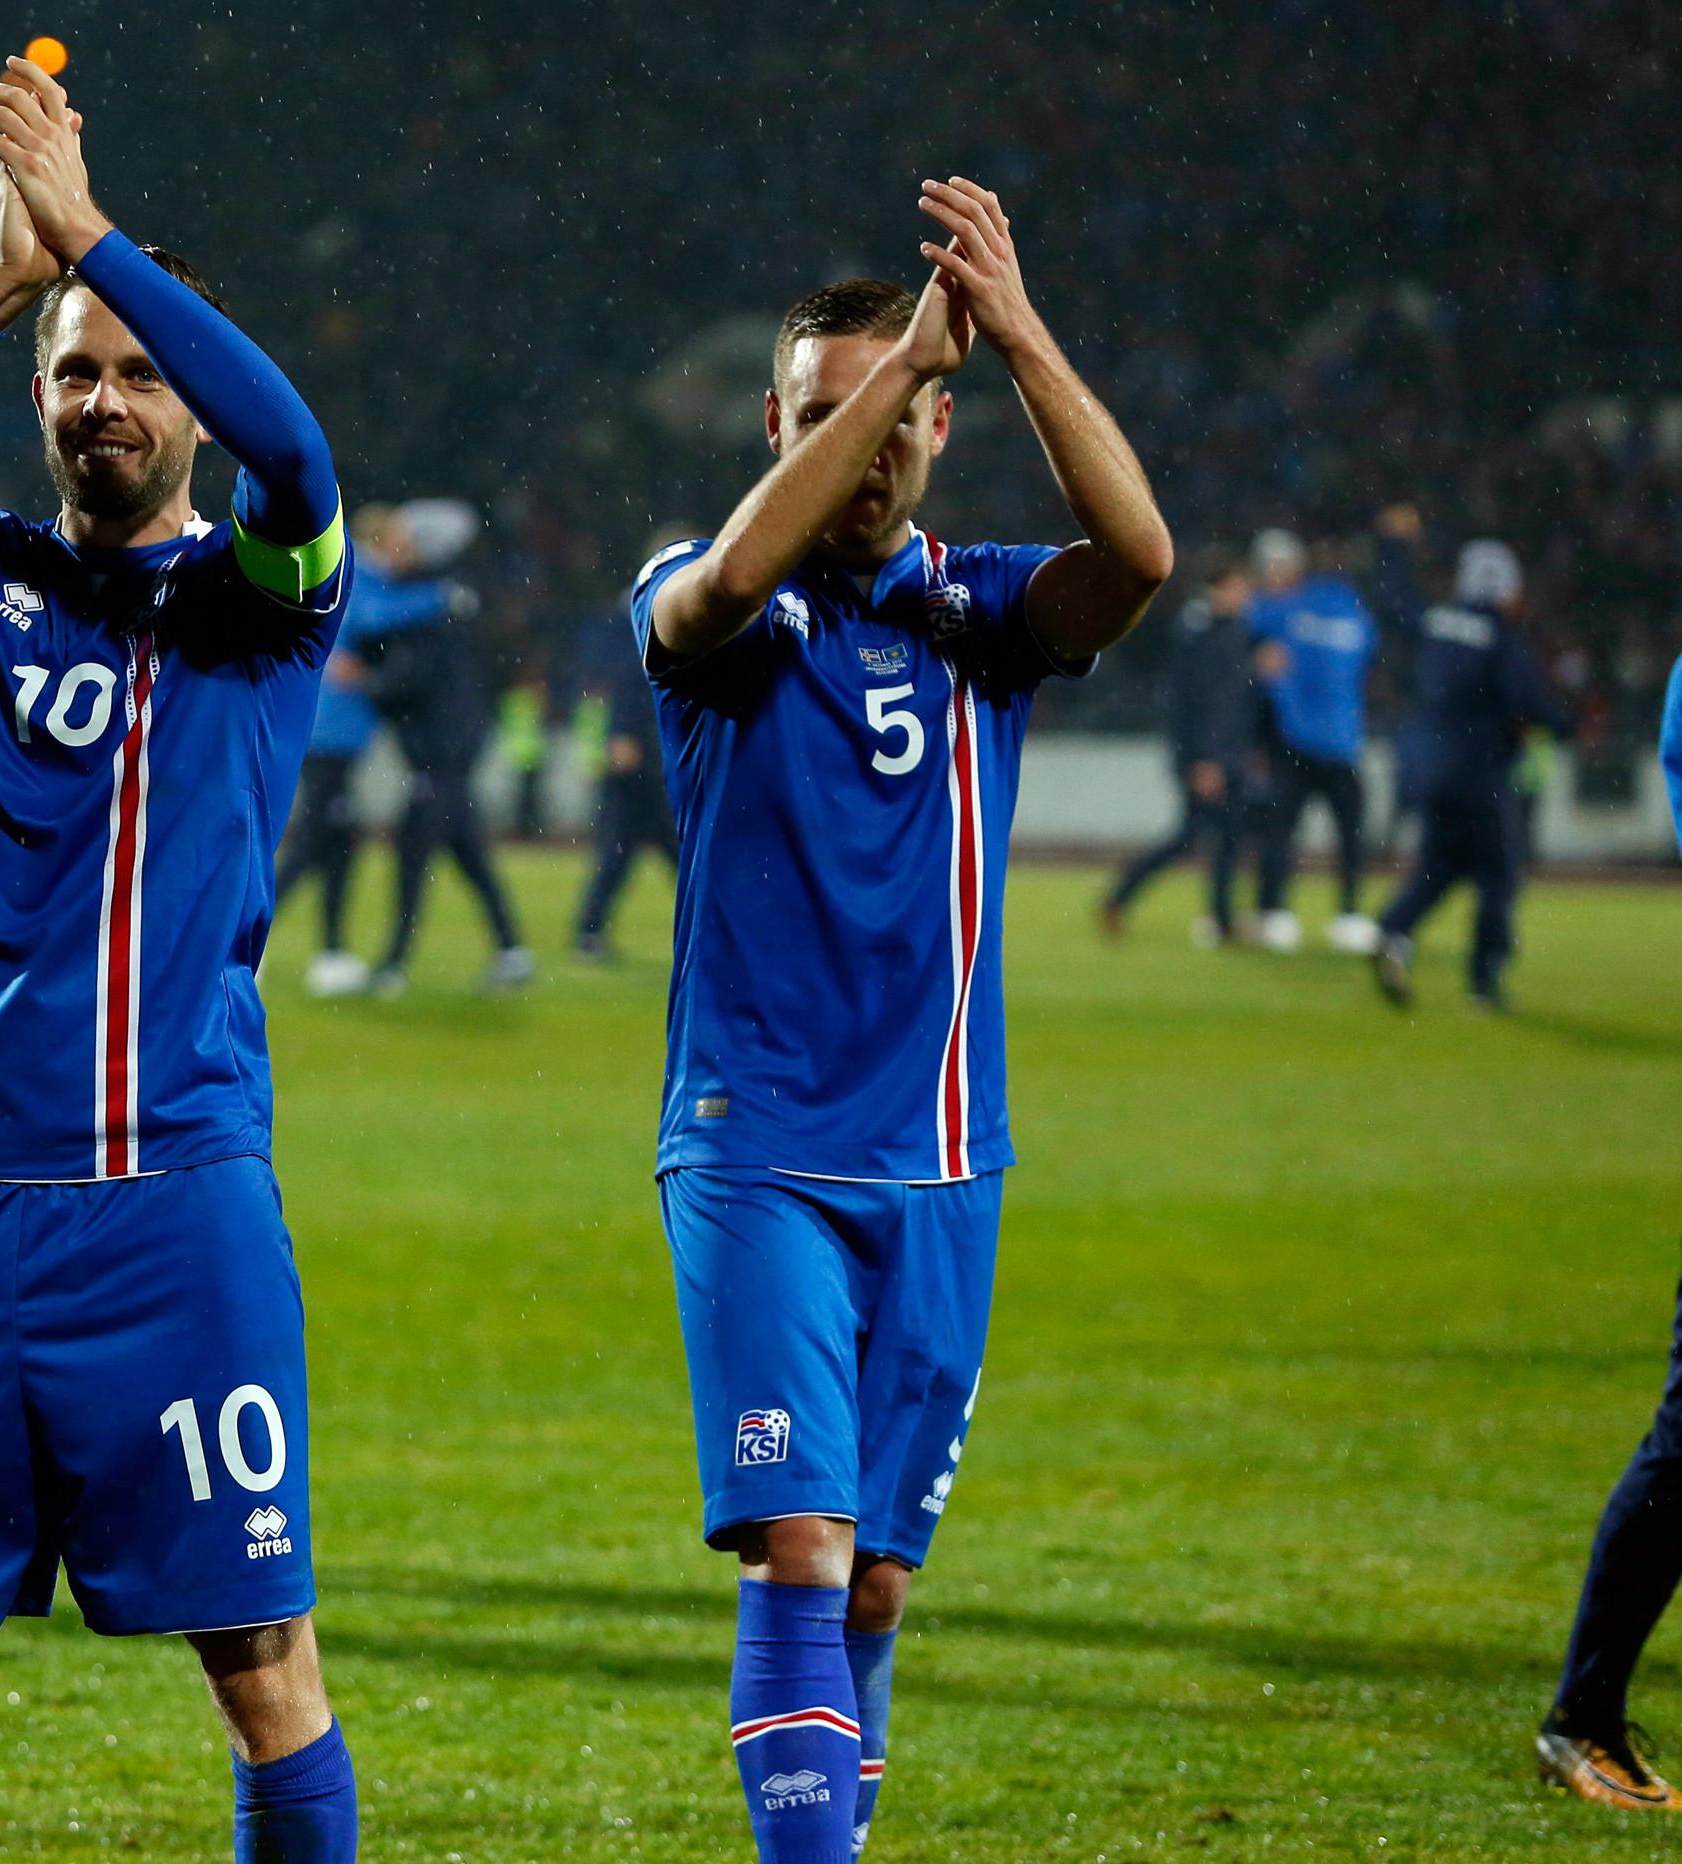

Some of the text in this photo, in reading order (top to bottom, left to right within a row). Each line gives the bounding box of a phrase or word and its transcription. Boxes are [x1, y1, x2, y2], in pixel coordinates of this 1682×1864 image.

[12, 662, 118, 747] 10
[865, 682, 925, 775] 5
[159, 1383, 287, 1502] 10
[737, 1433, 786, 1464] KSI
[246, 1537, 293, 1560] errea
[764, 1788, 831, 1811] errea
